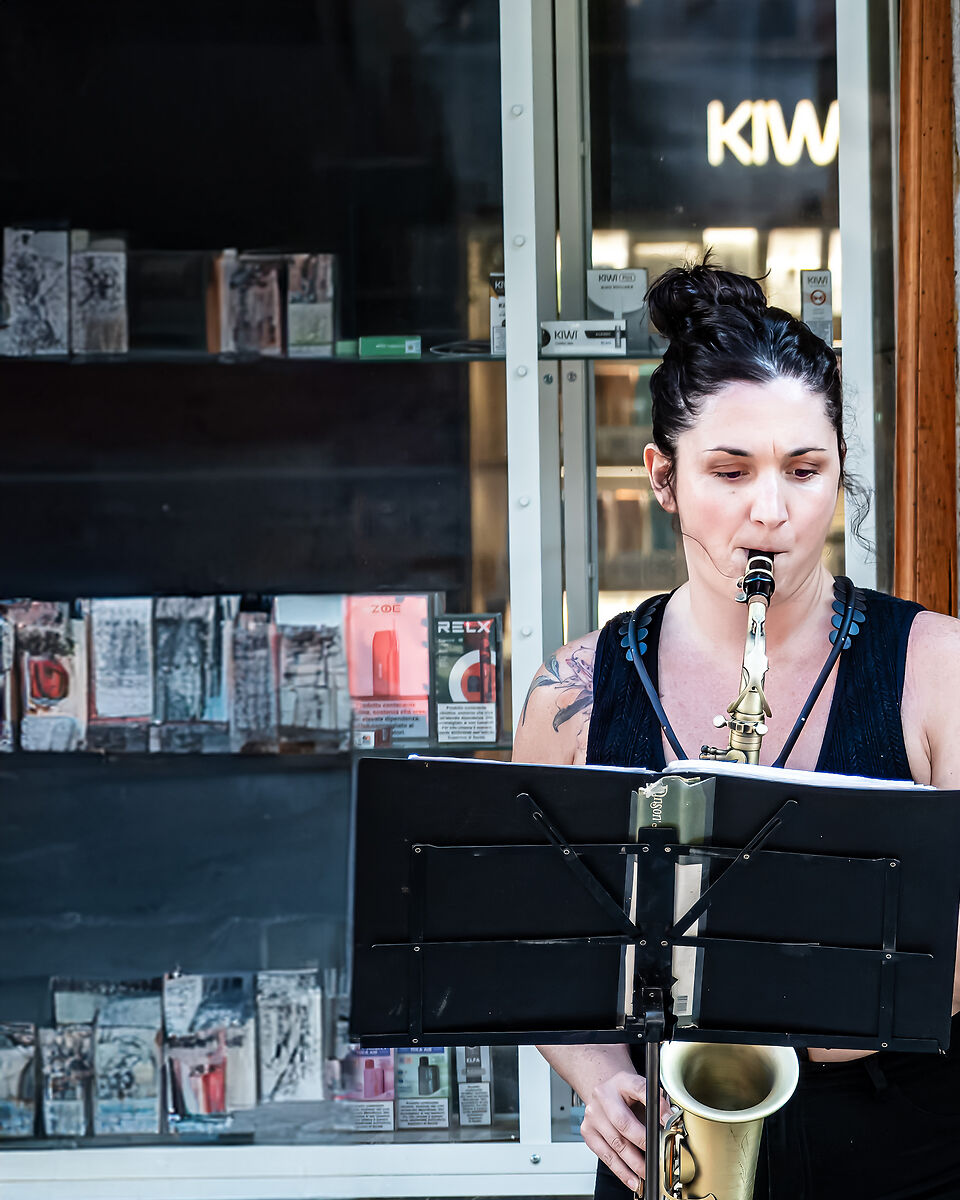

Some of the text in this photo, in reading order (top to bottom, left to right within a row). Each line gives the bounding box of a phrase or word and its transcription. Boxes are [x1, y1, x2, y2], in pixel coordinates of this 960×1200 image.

[707, 98, 839, 166] KIW
[599, 273, 618, 282] KIWI
[807, 275, 828, 285] KIWI
[554, 330, 578, 340] KIWI
[371, 603, 401, 614] ZOE
[437, 620, 491, 634] RELX
